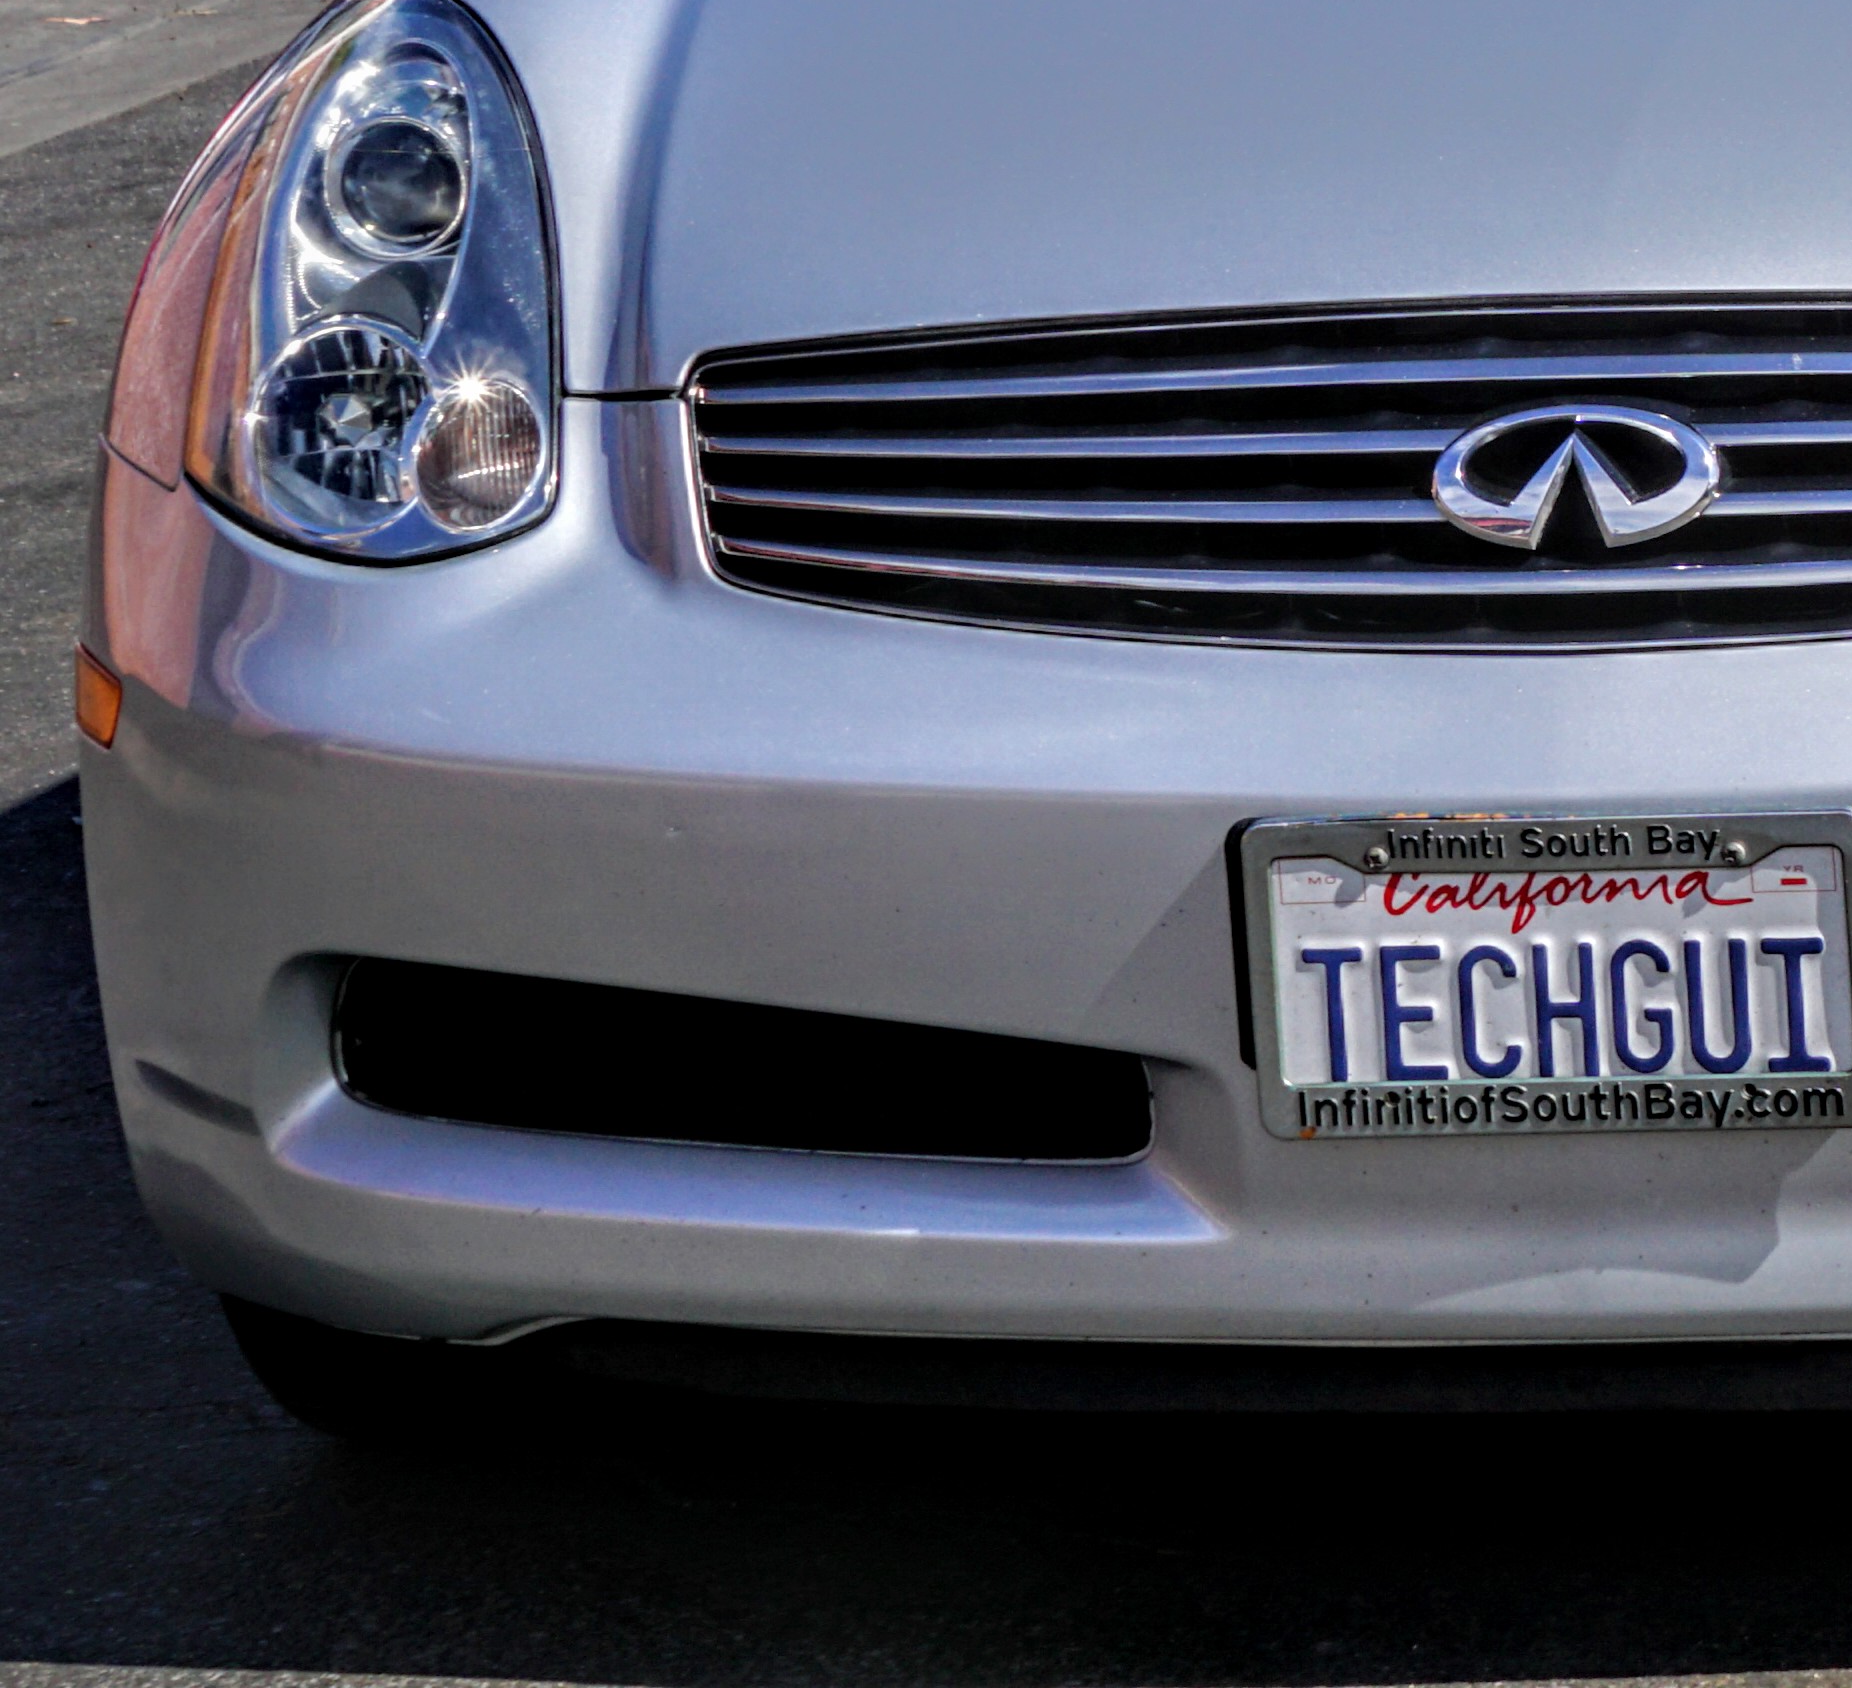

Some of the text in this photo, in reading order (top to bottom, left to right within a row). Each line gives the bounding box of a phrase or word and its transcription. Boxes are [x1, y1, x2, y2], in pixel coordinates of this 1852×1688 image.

[1387, 824, 1720, 861] Infiniti South Bay
[1307, 875, 1337, 886] MO
[1383, 872, 1754, 934] California
[1301, 935, 1832, 1083] TECHGUI
[1298, 1082, 1845, 1129] InfinitiofSouthBay.com
